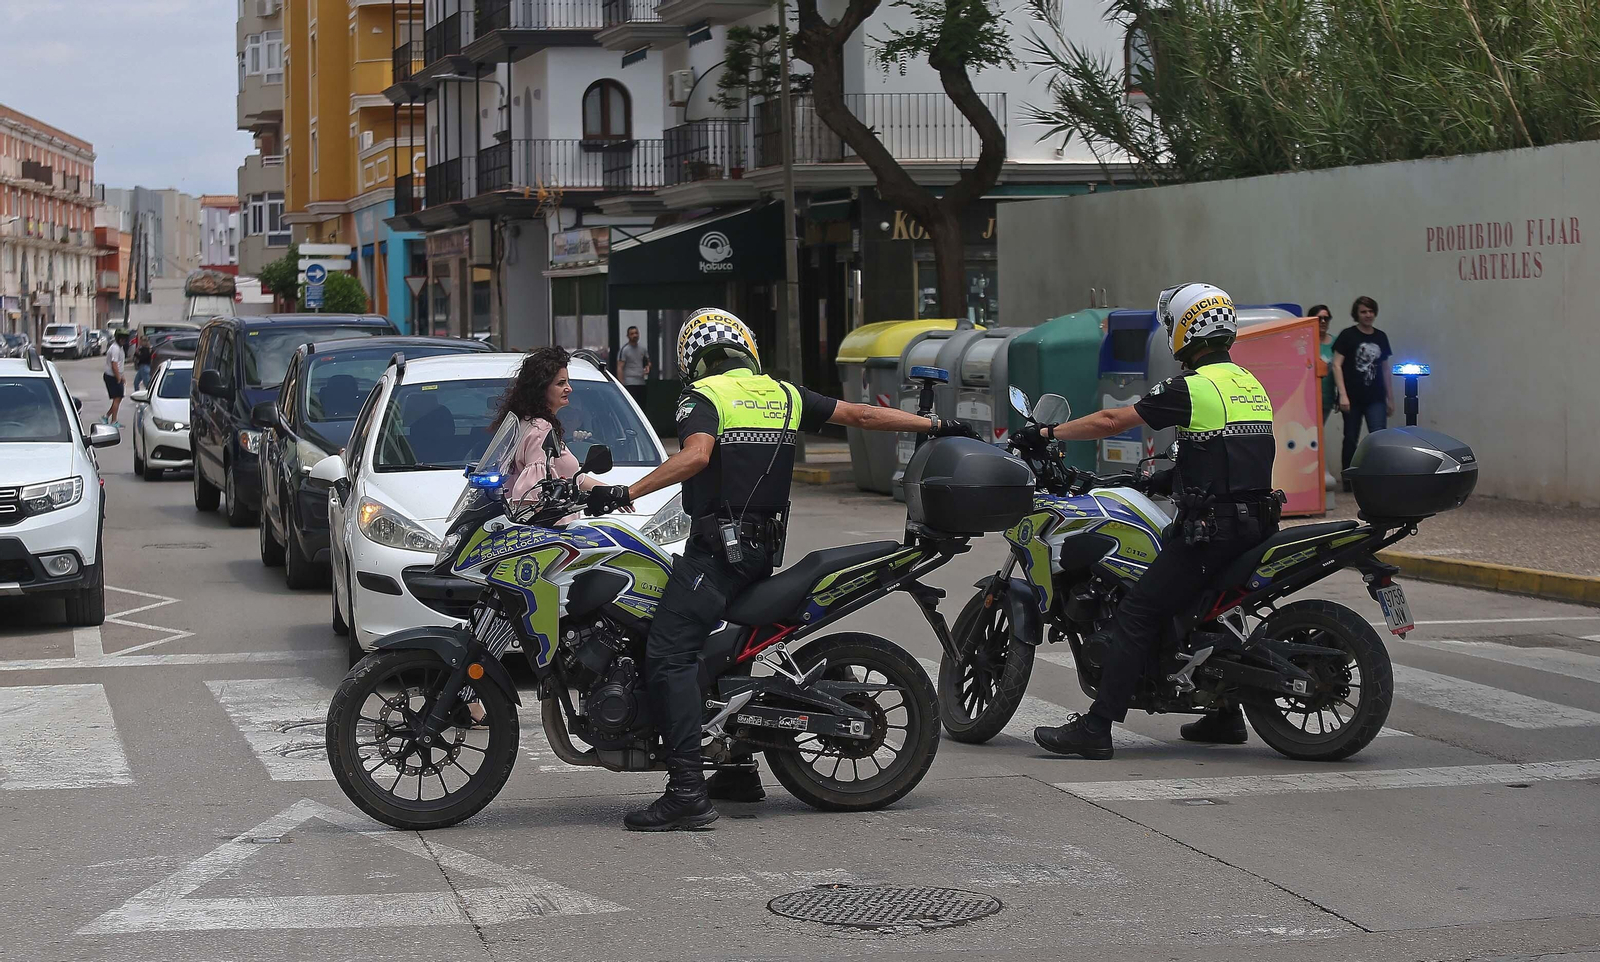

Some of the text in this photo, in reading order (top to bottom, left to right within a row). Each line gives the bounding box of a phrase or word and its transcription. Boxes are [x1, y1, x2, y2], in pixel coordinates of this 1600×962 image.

[1426, 217, 1581, 252] PROHIBIDO FIJAR
[699, 261, 733, 273] Katuca
[1458, 252, 1543, 281] CARTELES
[1180, 297, 1220, 328] POLICIA
[678, 315, 745, 355] OLICIA LOCAL
[1230, 395, 1269, 404] POLICIA
[481, 536, 545, 561] POLICIA LOCAL
[1132, 549, 1148, 558] 112
[1384, 588, 1405, 608] 9758
